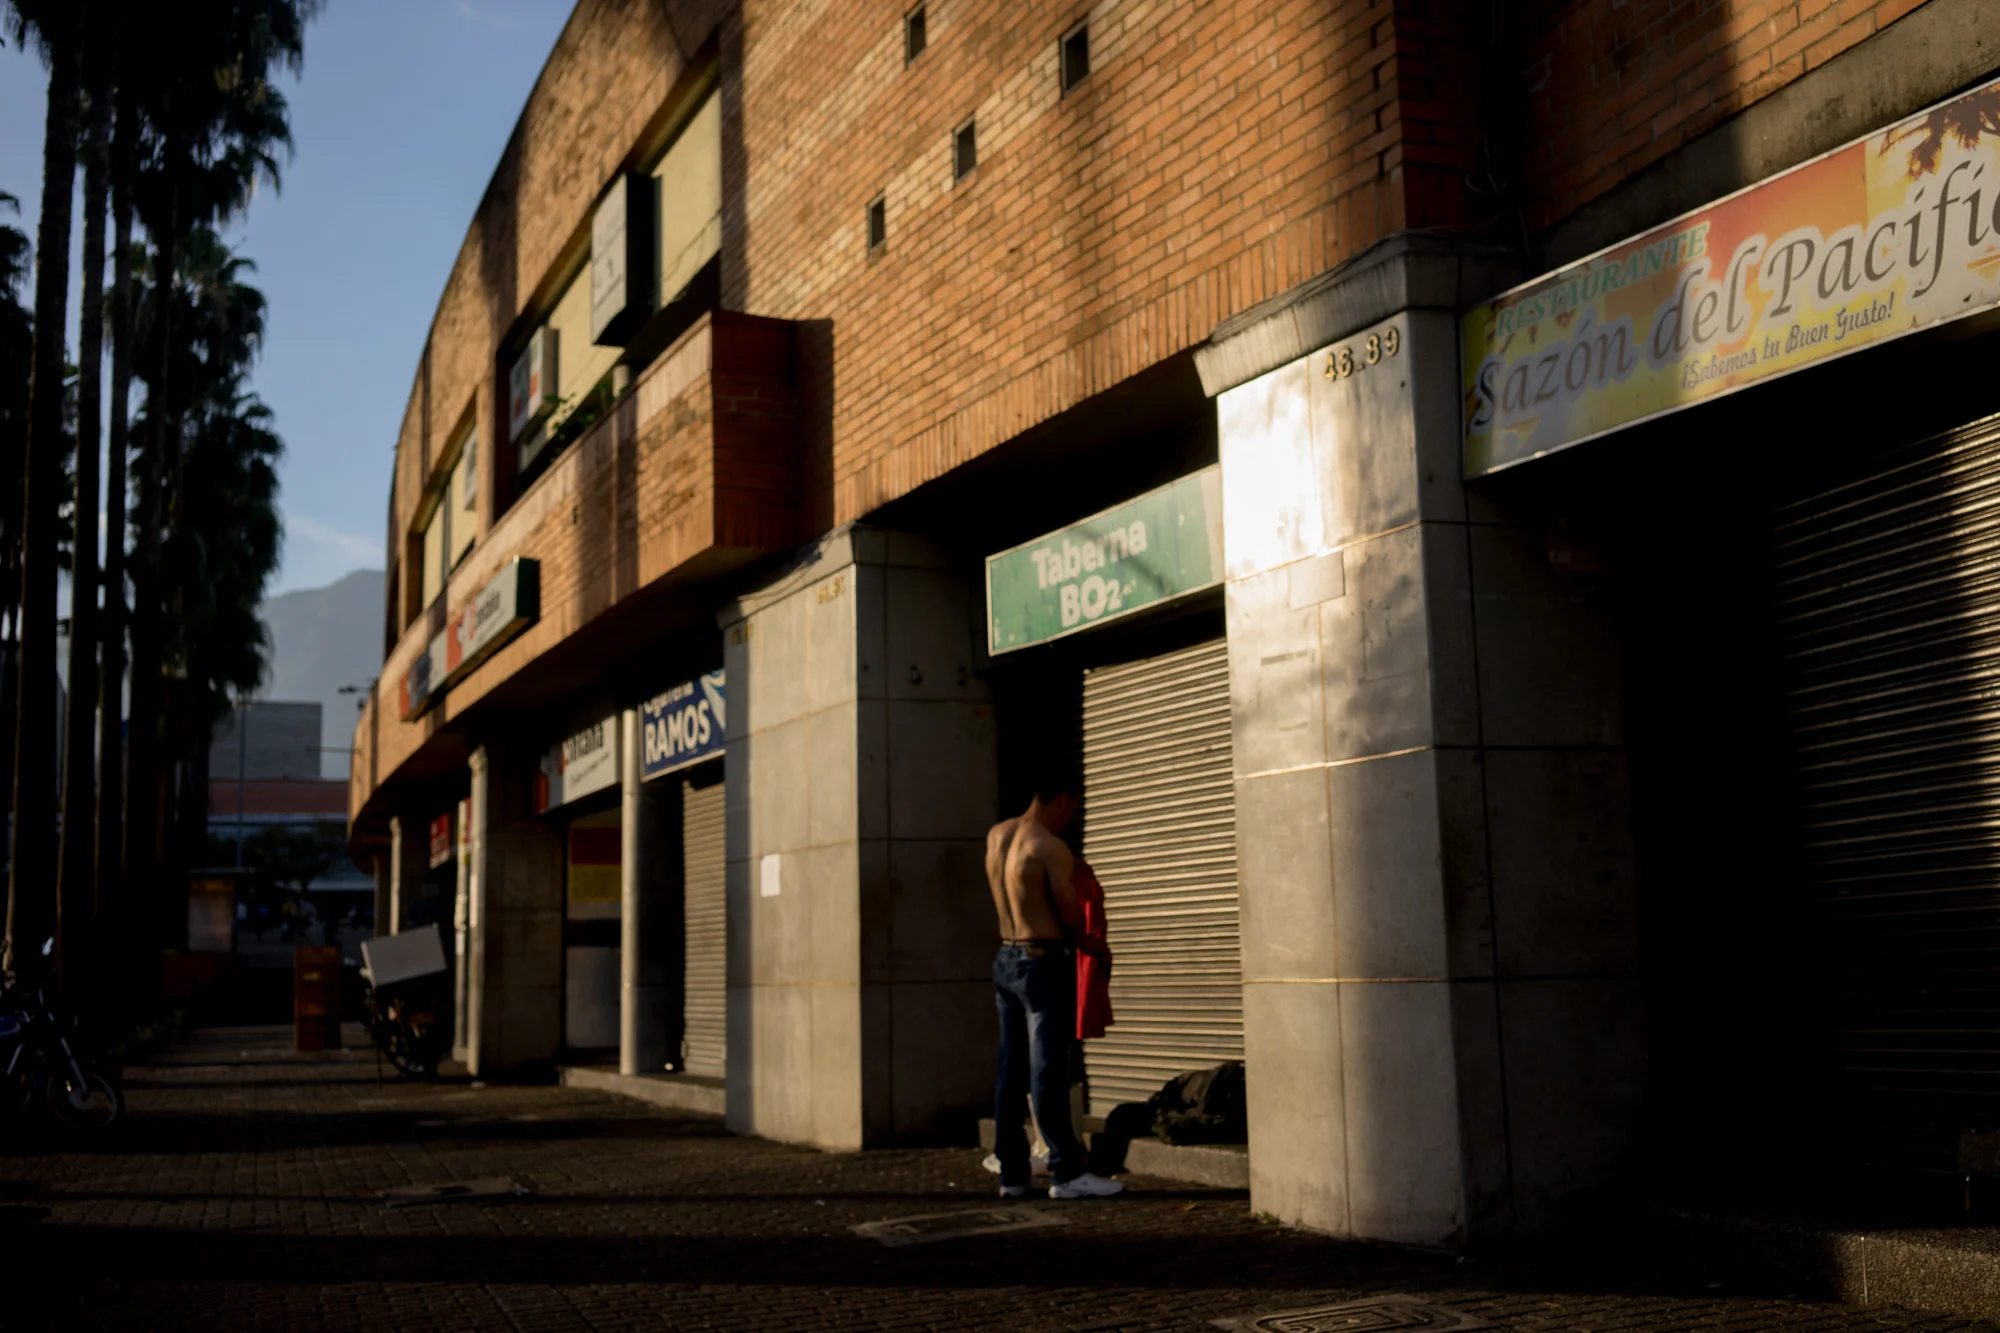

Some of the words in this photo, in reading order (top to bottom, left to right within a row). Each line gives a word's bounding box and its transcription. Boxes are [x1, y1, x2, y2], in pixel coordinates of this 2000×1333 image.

[1497, 224, 1709, 337] RESTAURANTE
[1474, 319, 1635, 427] Sazón
[1654, 245, 1757, 355] del
[1761, 335, 1780, 362] tu
[1787, 319, 1830, 354] Buen
[1031, 520, 1148, 589] Taberna
[645, 699, 711, 765] RAMOS
